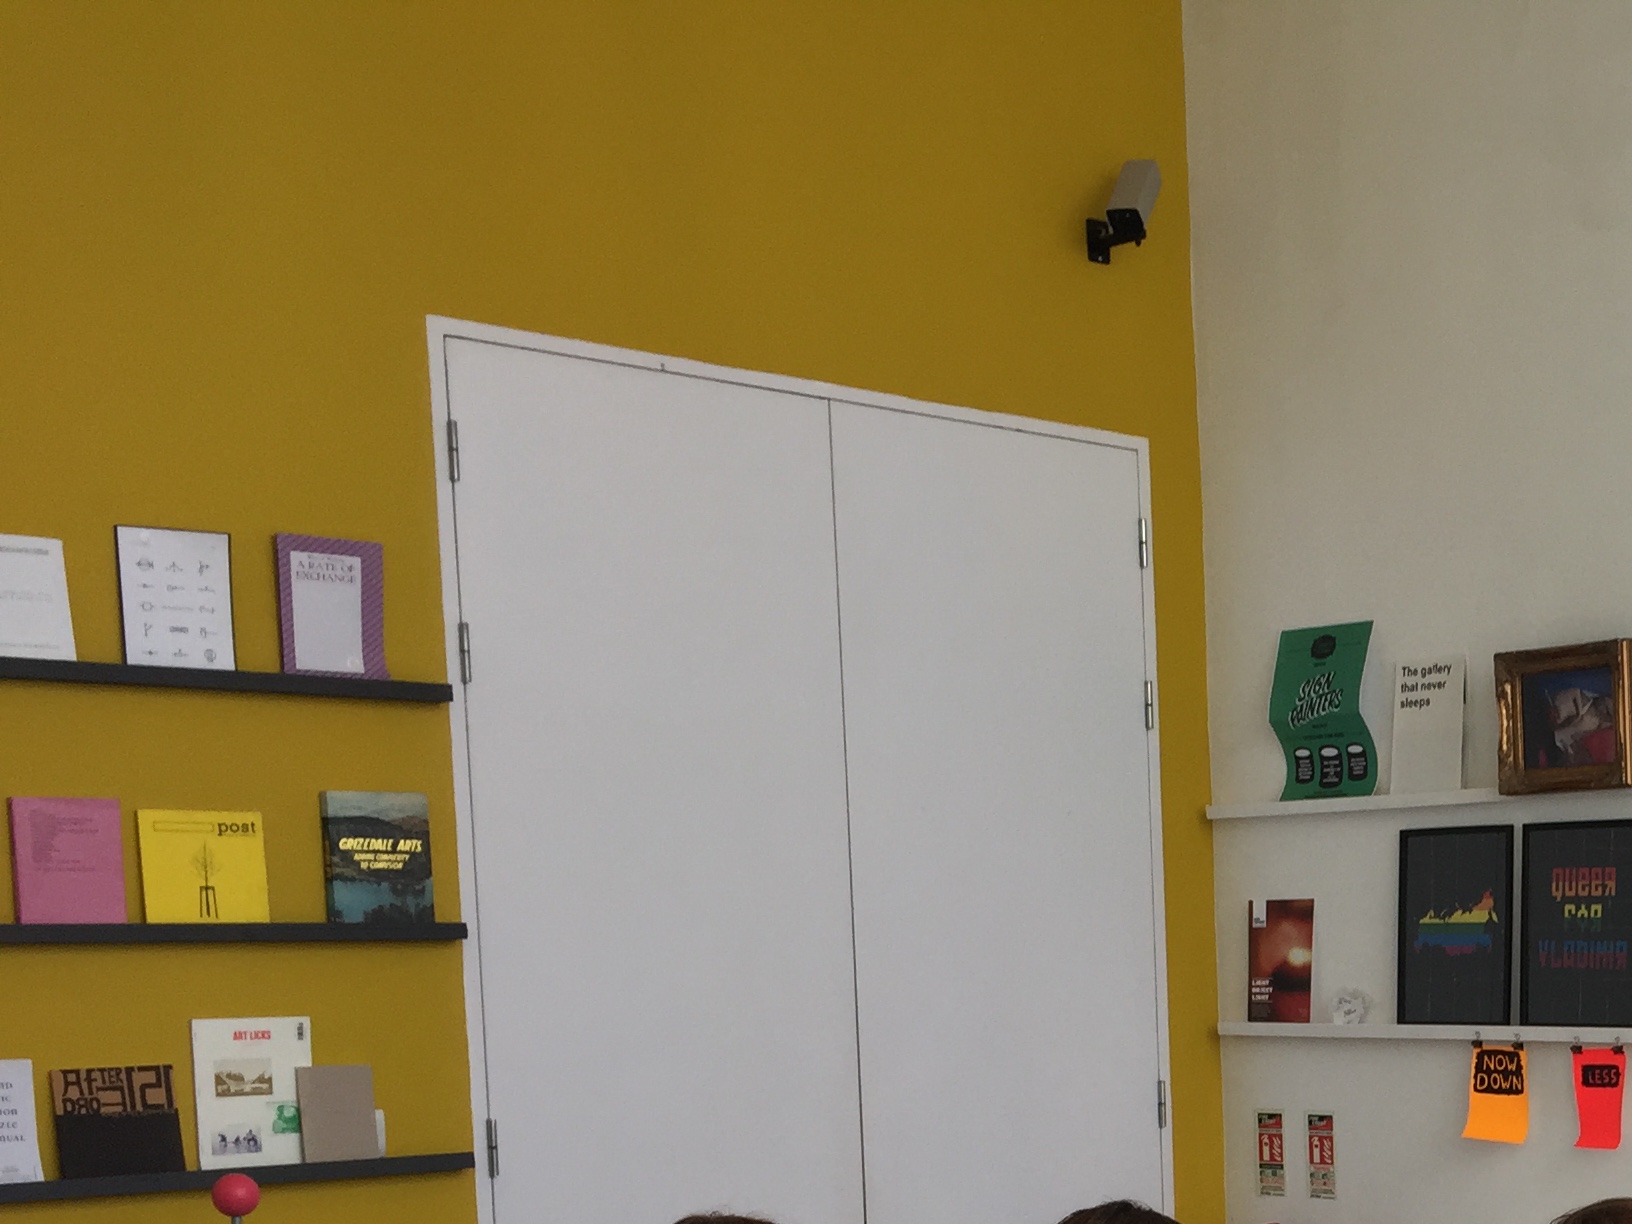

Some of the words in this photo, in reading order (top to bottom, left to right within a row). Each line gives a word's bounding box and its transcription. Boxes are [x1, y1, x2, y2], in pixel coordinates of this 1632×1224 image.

[1402, 666, 1418, 677] The
[1421, 663, 1452, 679] gallery
[1296, 672, 1336, 704] SIGN
[1401, 682, 1418, 692] that
[1421, 681, 1446, 691] never
[1400, 697, 1430, 710] sleeps
[217, 821, 256, 836] post
[397, 838, 422, 852] ARTS
[1483, 1055, 1517, 1071] NOW
[1477, 1073, 1521, 1090] DOWN
[1589, 1069, 1617, 1084] LESS
